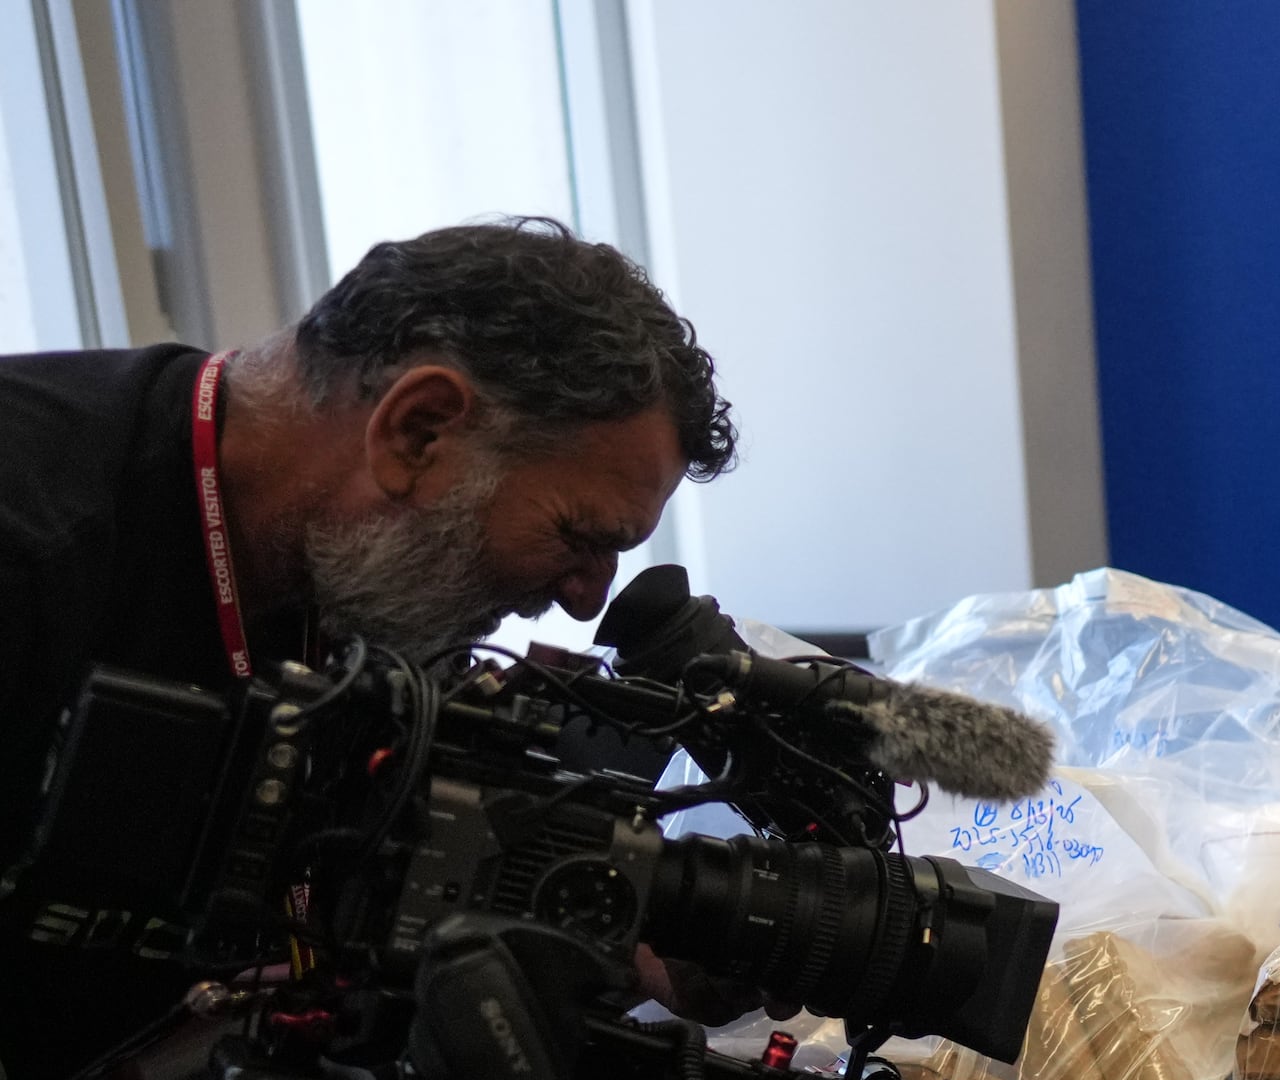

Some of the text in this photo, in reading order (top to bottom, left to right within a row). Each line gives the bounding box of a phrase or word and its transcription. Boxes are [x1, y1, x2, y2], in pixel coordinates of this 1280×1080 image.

[198, 366, 219, 421] ESCORTED
[201, 466, 234, 604] ESCORTED VISITOR
[481, 997, 533, 1072] SONY
